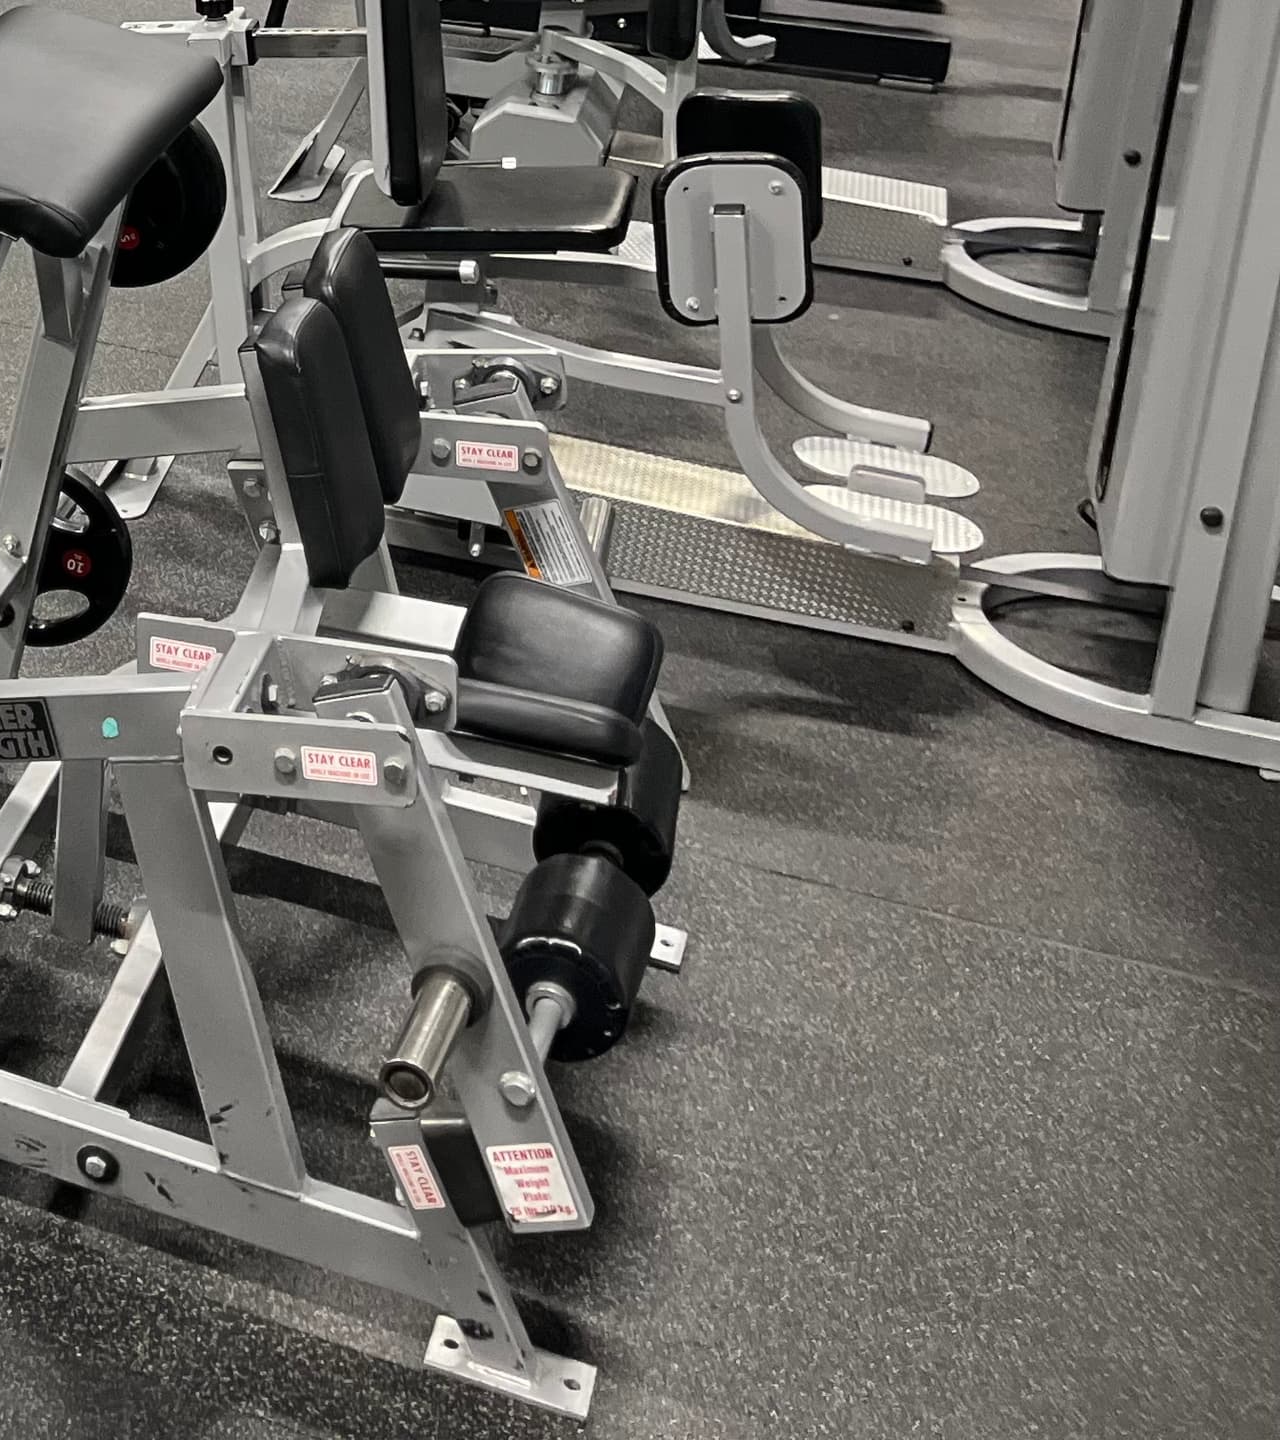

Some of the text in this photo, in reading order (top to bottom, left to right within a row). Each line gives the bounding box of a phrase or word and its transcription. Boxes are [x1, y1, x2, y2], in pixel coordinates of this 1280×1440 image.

[461, 446, 514, 459] STAY CLEAR
[66, 558, 85, 574] 10
[155, 643, 180, 656] STAY
[308, 753, 372, 769] STAY CLEAR
[493, 1147, 554, 1163] ATTENTION
[405, 1150, 425, 1174] STAY
[417, 1176, 438, 1204] CLEAR
